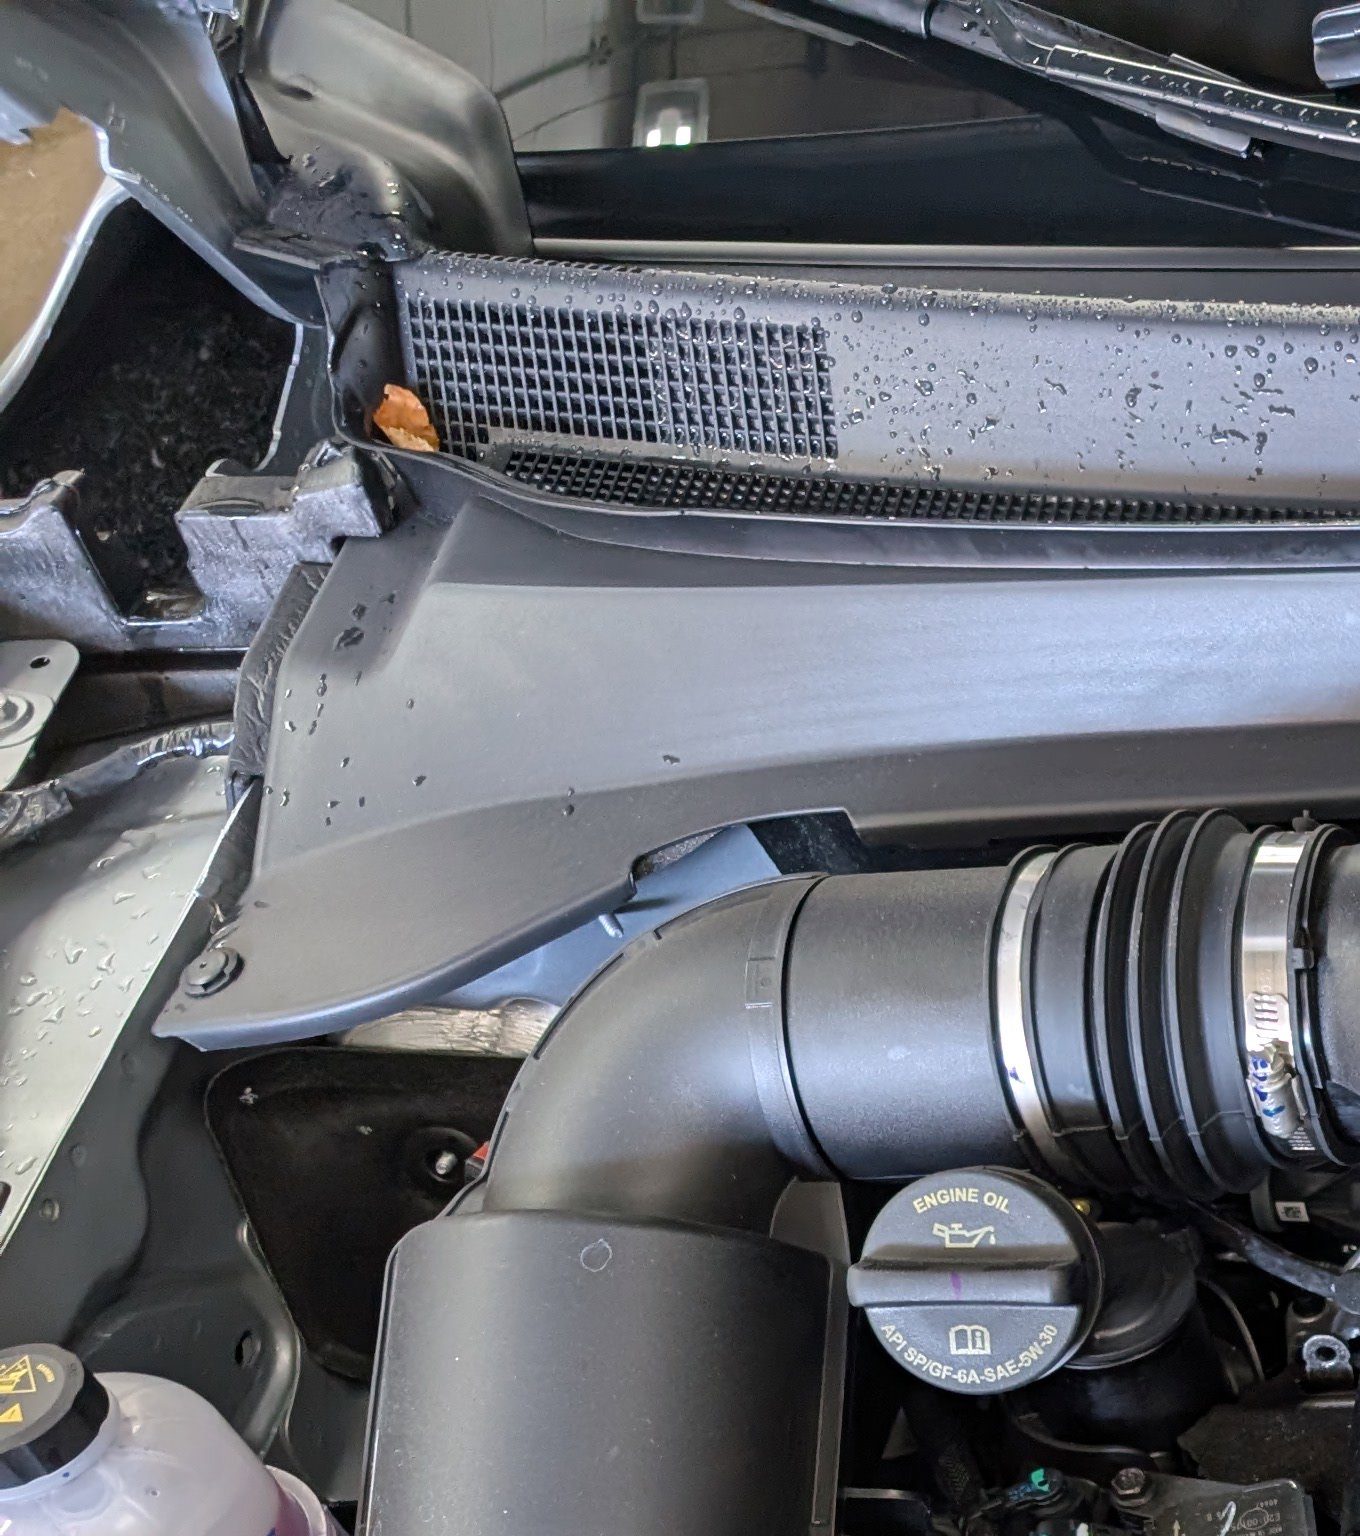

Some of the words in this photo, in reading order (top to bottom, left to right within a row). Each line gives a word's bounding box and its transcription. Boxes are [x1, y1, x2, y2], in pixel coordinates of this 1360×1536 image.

[912, 1187, 979, 1214] ENGINE
[983, 1191, 1010, 1214] OIL
[881, 1323, 905, 1352] API
[903, 1324, 1058, 1384] SP/GF-6A-SAE-5W-30
